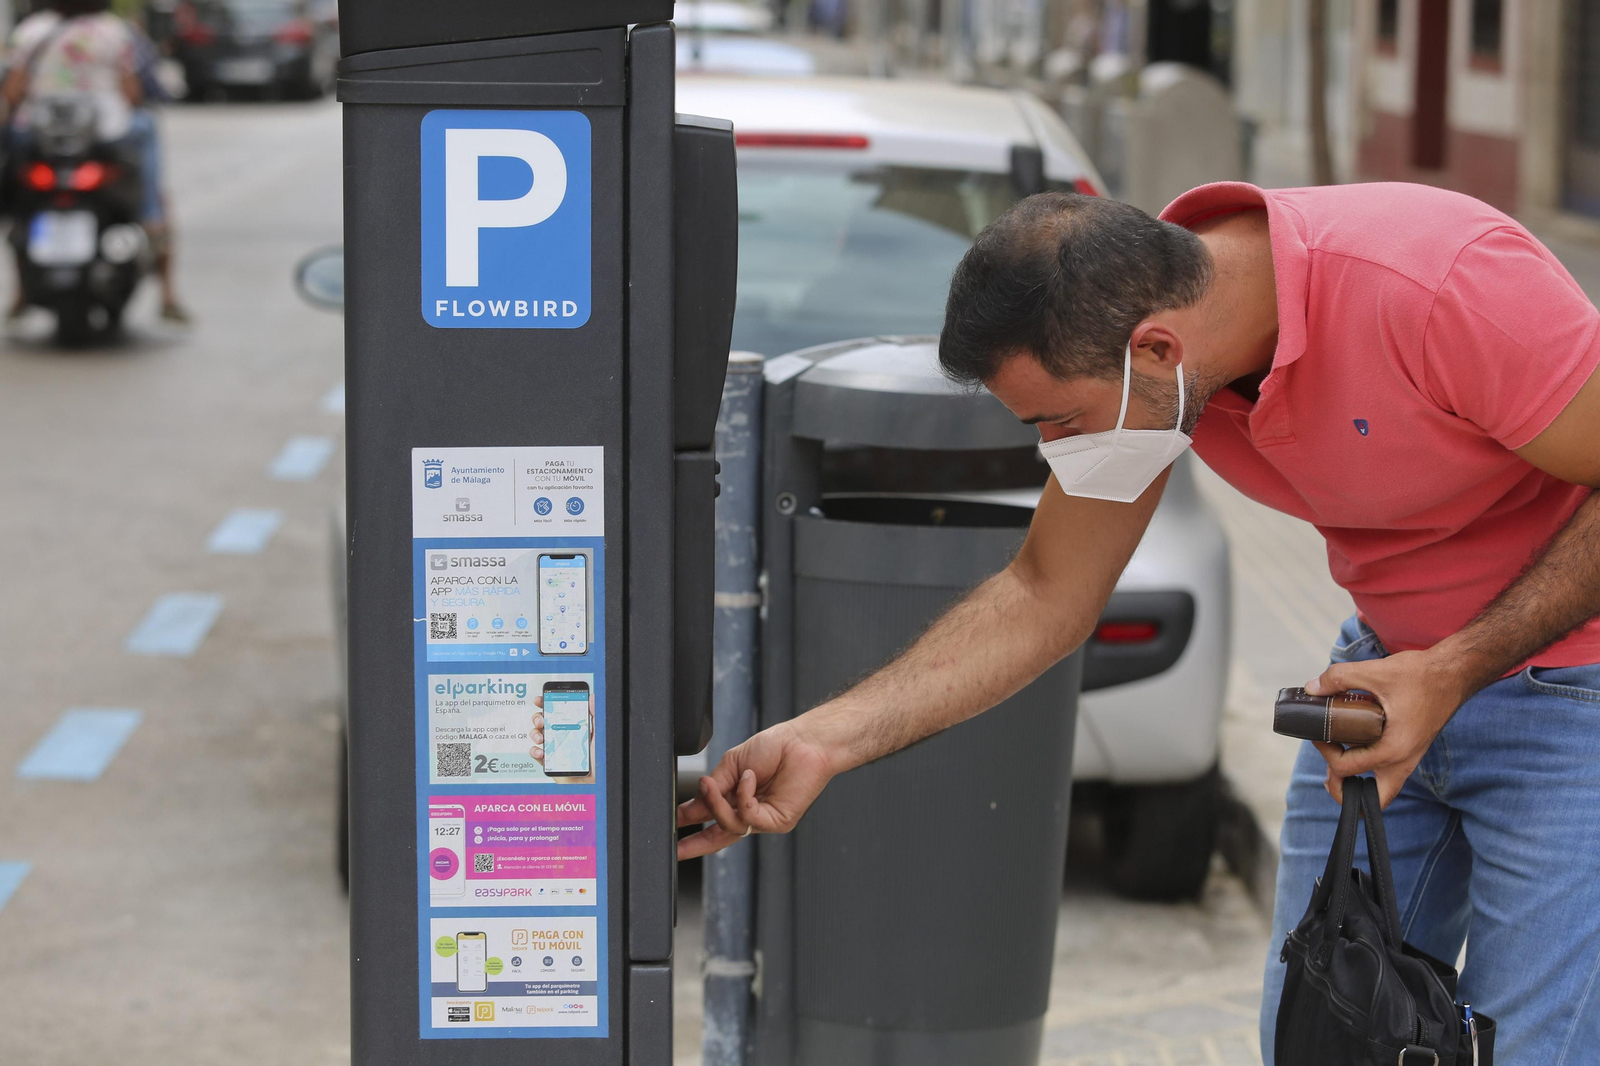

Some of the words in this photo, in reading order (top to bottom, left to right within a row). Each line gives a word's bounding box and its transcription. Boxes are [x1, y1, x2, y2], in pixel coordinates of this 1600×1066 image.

[446, 129, 567, 287] P
[436, 300, 577, 317] FLOWBIRD
[451, 467, 505, 475] Ayuntamiento
[463, 476, 490, 484] Málaga
[443, 514, 482, 522] smassa
[450, 556, 506, 567] smassa
[430, 576, 474, 585] APARCA
[477, 576, 501, 584] CON
[505, 576, 518, 584] LA
[455, 586, 479, 595] MÁS
[482, 586, 520, 595] RÁPIDA
[442, 598, 486, 607] SEGURA
[435, 678, 527, 699] elparking
[474, 755, 499, 773] 2€
[474, 804, 515, 812] APARCA
[518, 804, 542, 812] CON
[543, 804, 553, 812] EL
[556, 802, 586, 812] MÓVIL
[434, 827, 460, 836] 12:27
[532, 931, 559, 939] PAGA
[563, 930, 583, 939] CON
[532, 942, 546, 950] TU
[549, 940, 581, 950] MÓVIL
